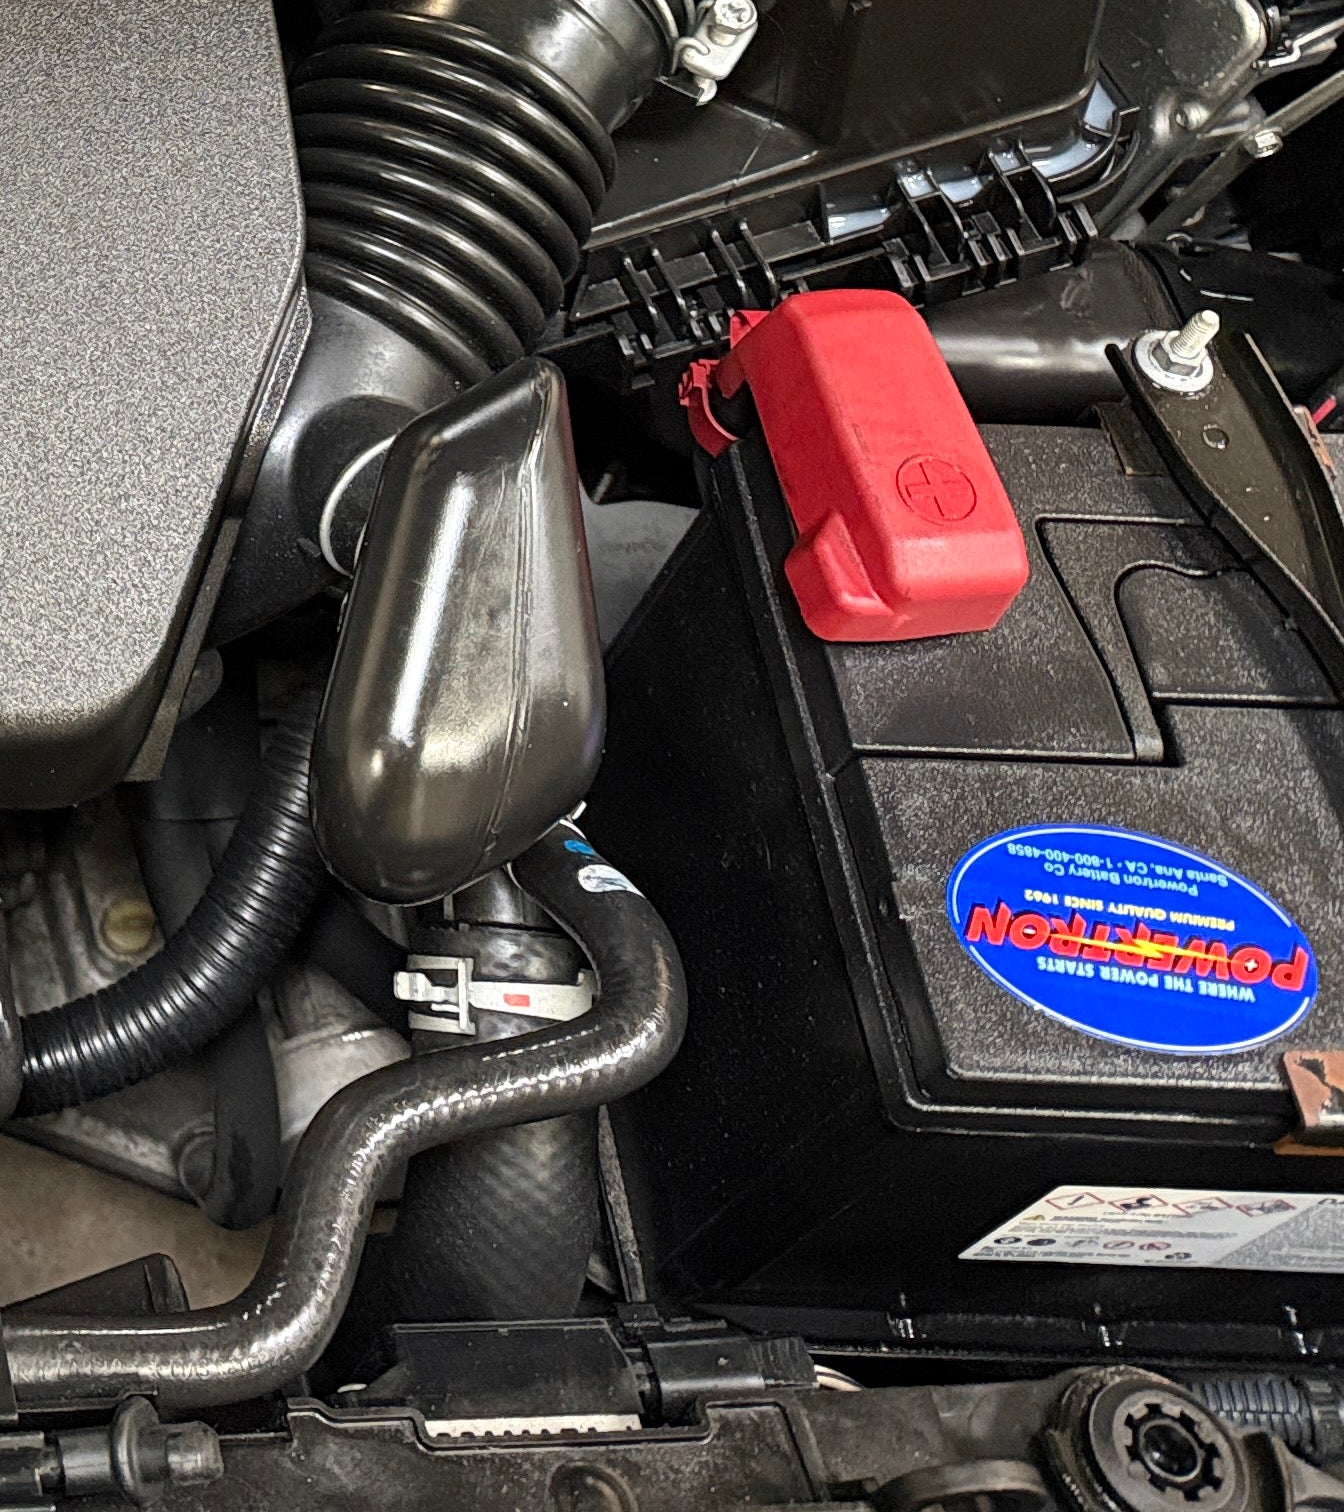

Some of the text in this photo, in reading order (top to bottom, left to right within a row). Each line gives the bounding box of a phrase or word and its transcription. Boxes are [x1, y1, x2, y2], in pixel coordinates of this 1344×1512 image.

[1006, 842, 1229, 888] Santa Ana, CA 1-800-400-4858
[1043, 861, 1199, 897] Powertron Battery Co
[1023, 888, 1236, 932] PREMIUM QUALITY SINCE 1962
[965, 902, 1309, 992] POWERTRON
[1037, 956, 1256, 1003] WHERE THE POWER STARTS
